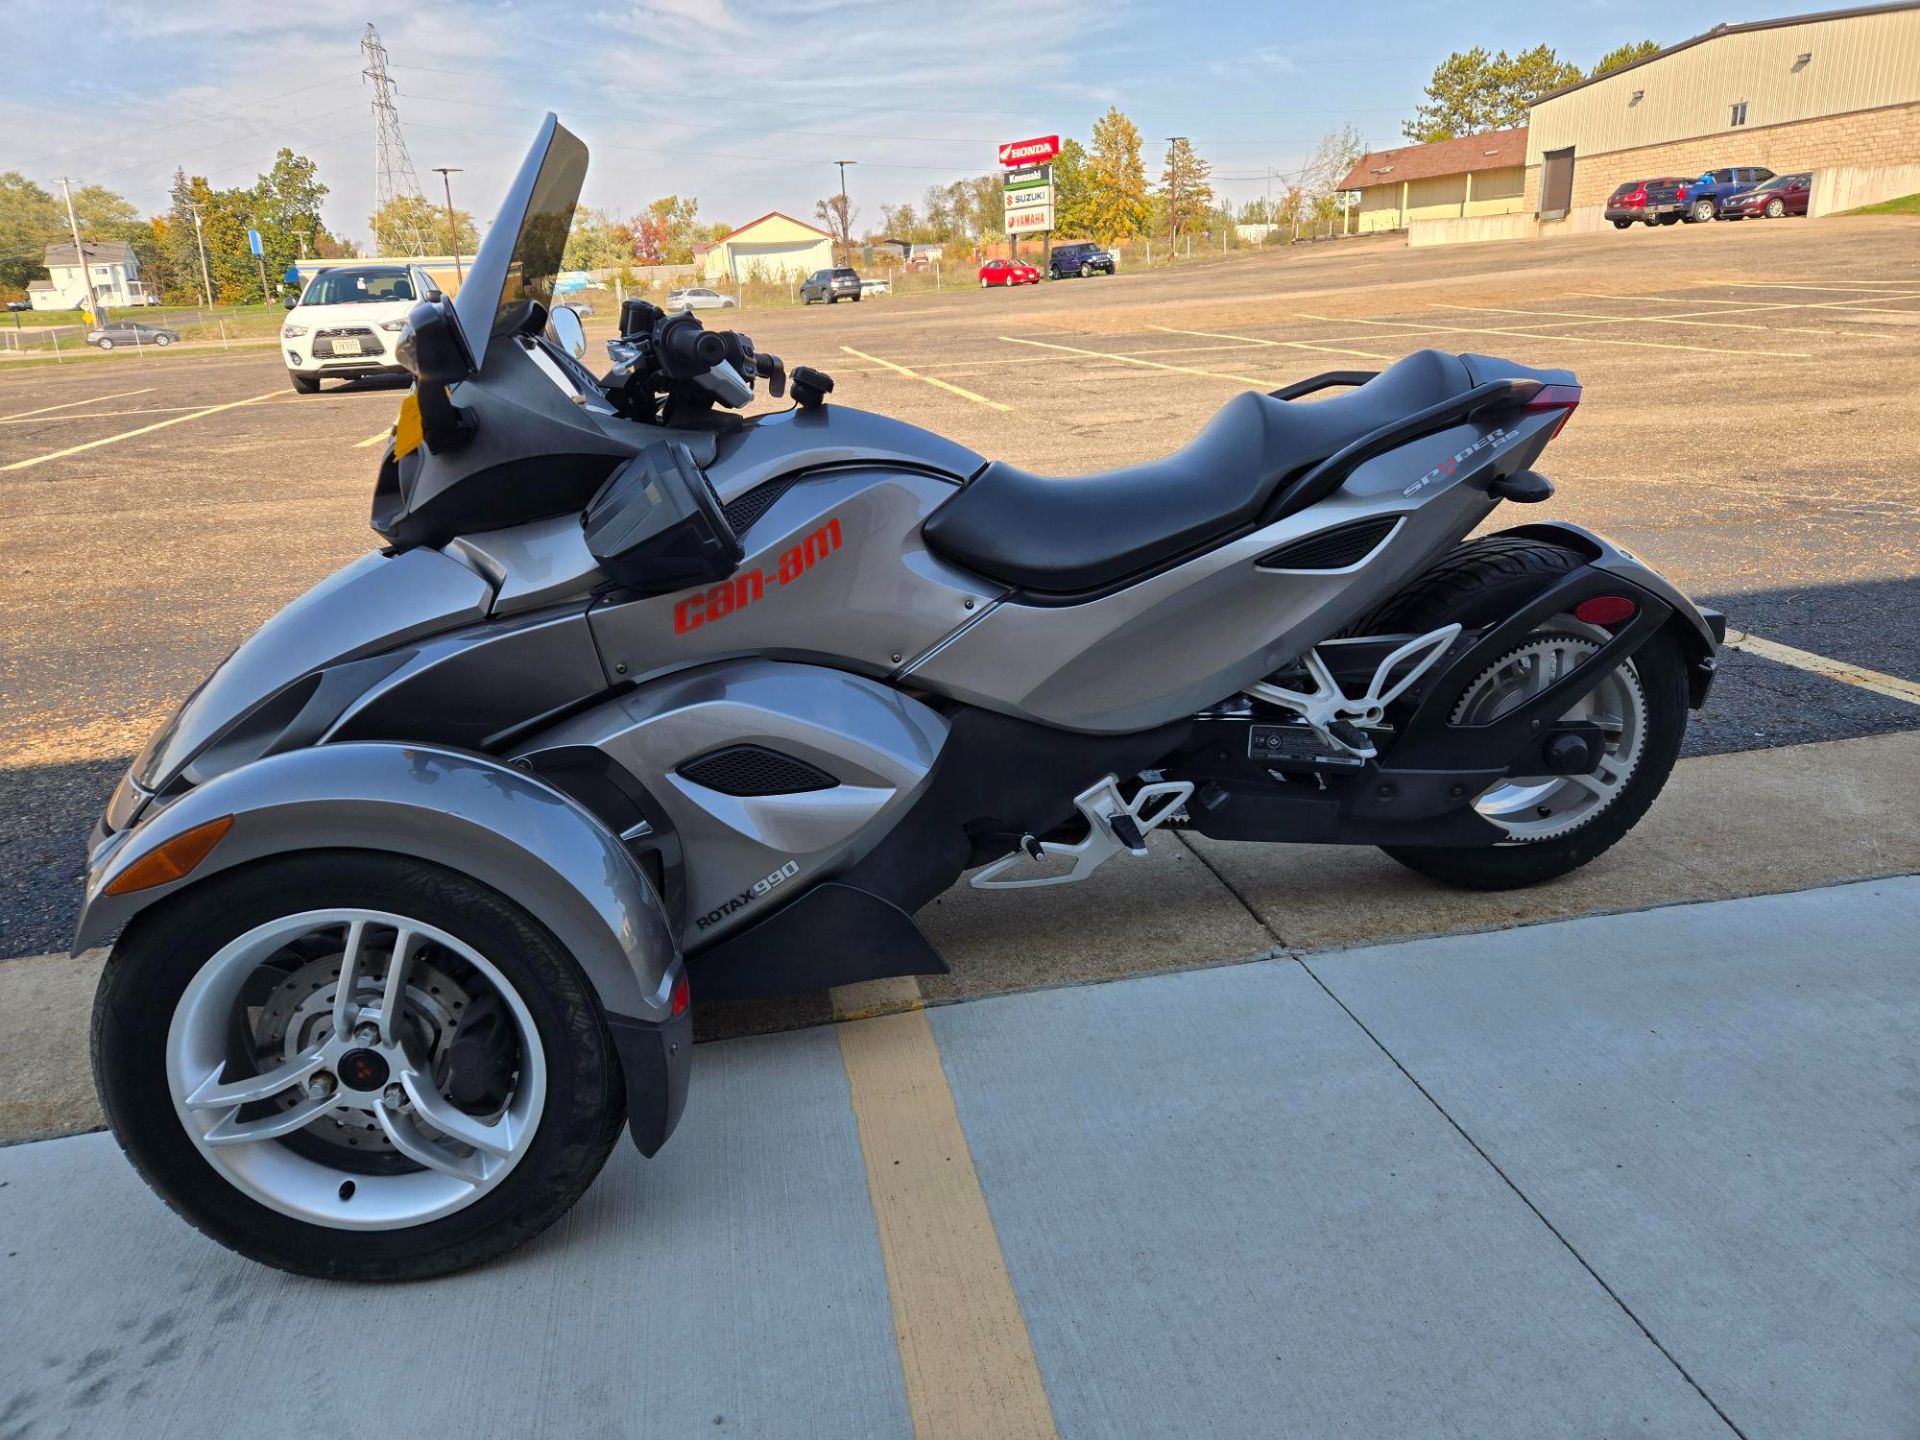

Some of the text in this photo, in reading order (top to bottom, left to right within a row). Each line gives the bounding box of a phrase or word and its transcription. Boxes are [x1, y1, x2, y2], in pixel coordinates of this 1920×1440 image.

[1011, 143, 1053, 158] HONDA
[1015, 192, 1045, 203] SUZUKI
[1016, 212, 1045, 227] YAMAHA
[673, 517, 843, 635] can-am
[696, 860, 800, 929] ROTAX 990
